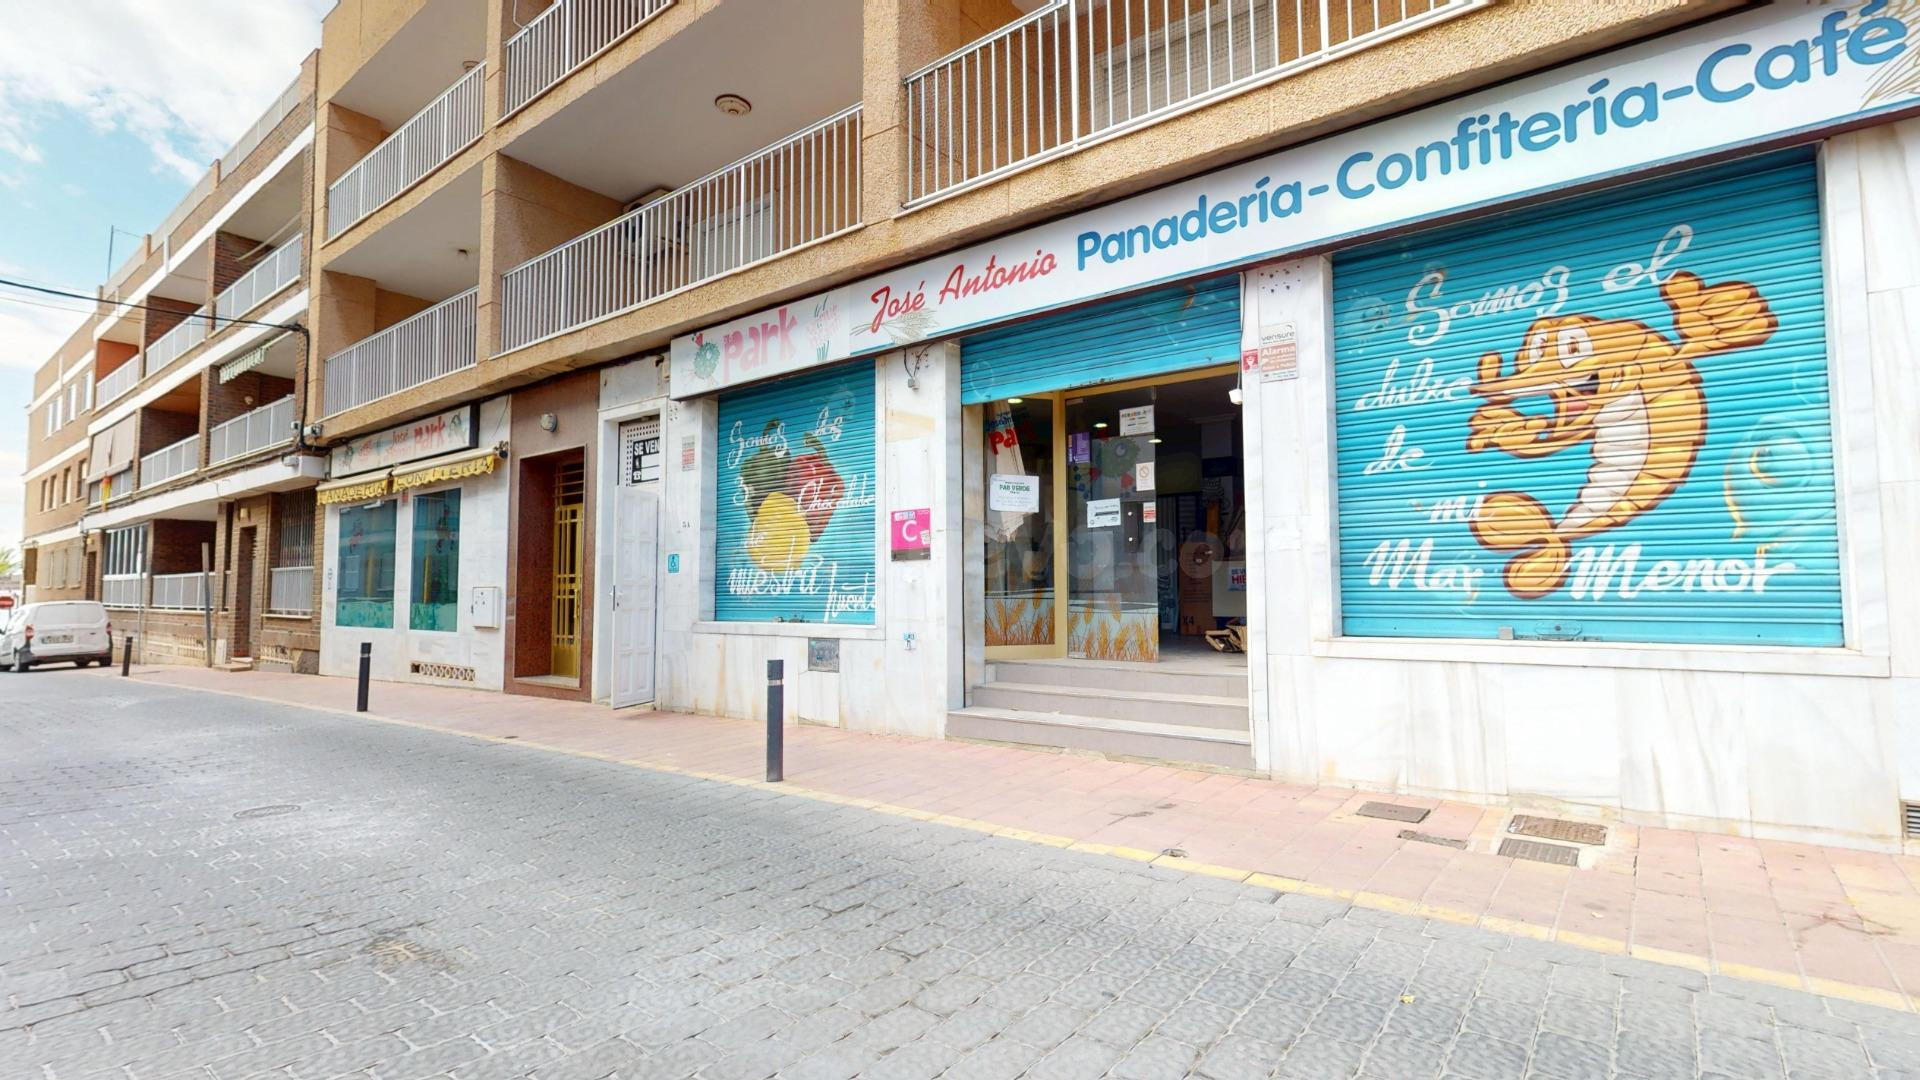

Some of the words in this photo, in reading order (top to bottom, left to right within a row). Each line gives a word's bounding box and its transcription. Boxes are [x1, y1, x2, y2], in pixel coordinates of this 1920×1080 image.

[871, 281, 926, 333] José
[939, 249, 1057, 304] Antonio
[633, 441, 644, 457] SE
[902, 519, 918, 542] C
